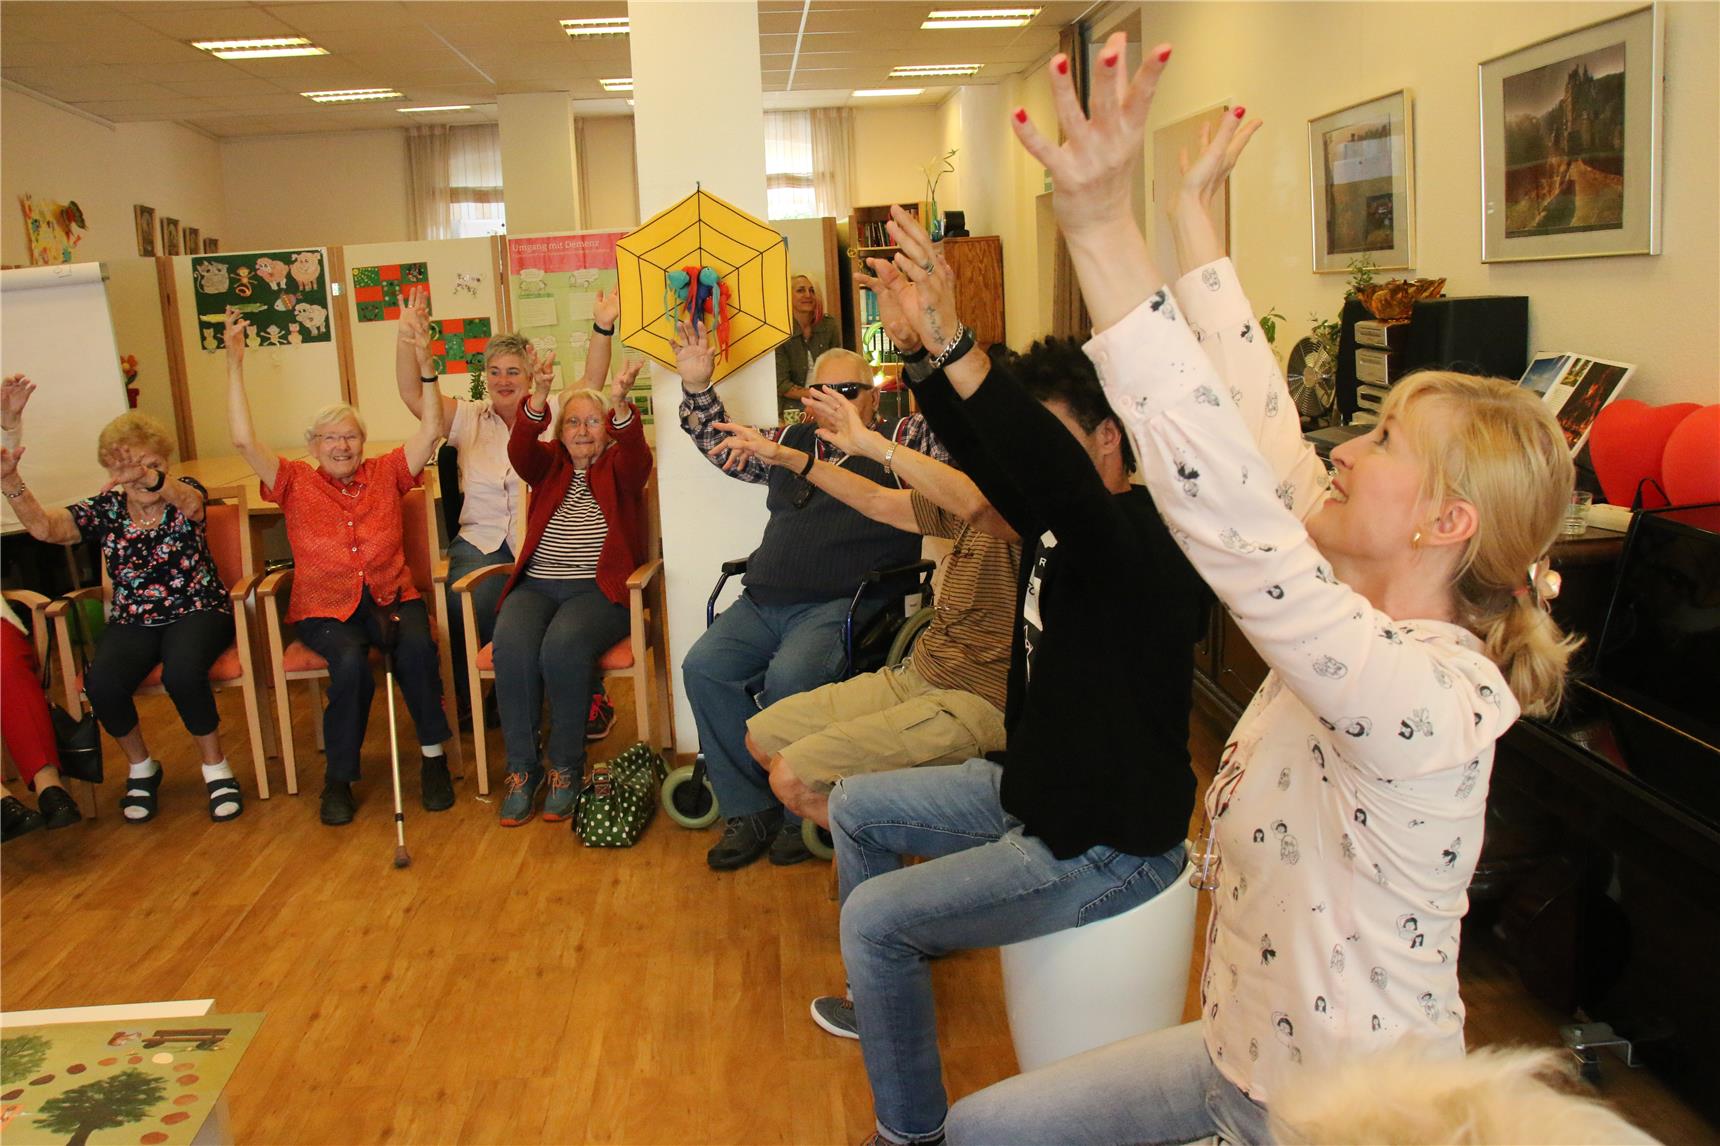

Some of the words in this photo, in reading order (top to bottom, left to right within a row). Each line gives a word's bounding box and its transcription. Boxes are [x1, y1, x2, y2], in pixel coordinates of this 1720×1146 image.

[512, 242, 547, 254] Umgang
[548, 241, 564, 250] mit
[565, 239, 600, 249] Demenz
